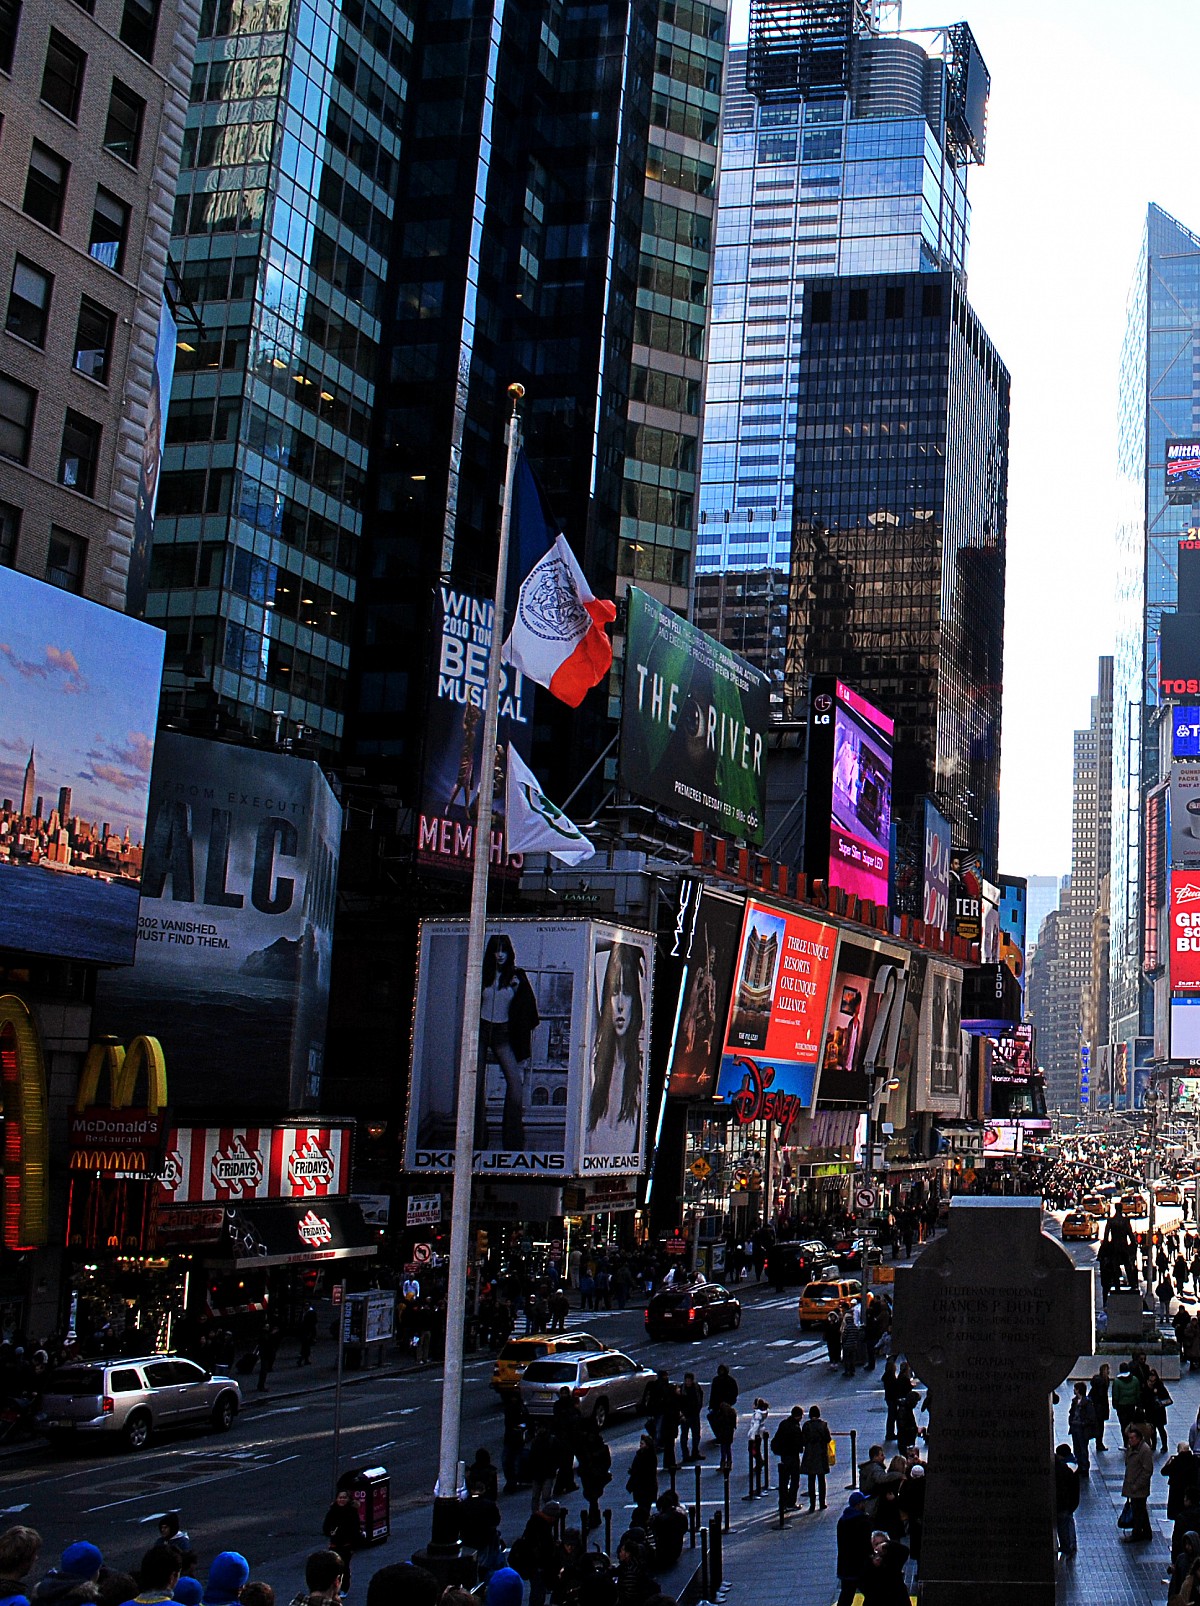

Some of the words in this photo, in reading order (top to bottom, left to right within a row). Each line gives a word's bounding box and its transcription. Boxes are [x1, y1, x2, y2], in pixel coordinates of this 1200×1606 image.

[439, 587, 496, 627] WINN
[443, 615, 469, 639] 2010
[472, 625, 493, 648] TON
[437, 675, 528, 723] MUSIAL
[636, 663, 679, 733] THE
[814, 715, 830, 724] LG
[706, 705, 763, 777] RIVER
[674, 780, 701, 803] PREMIERES
[702, 793, 723, 812] TUESDAY
[723, 802, 732, 816] FEB
[838, 838, 851, 857] Super
[851, 844, 861, 859] Slim
[862, 849, 874, 867] Super
[563, 894, 598, 902] LAMAR
[160, 918, 218, 936] VANISHED.
[168, 932, 195, 946] FIND
[197, 936, 231, 949] THEM.
[787, 935, 807, 953] THREE
[807, 940, 829, 961] UNIQUE
[781, 976, 794, 991] ONE
[794, 980, 817, 997] UNIQUE
[72, 1119, 158, 1133] McDonald's
[85, 1134, 142, 1143] Restaurant
[483, 1153, 565, 1169] JEANS
[583, 1157, 609, 1169] DKNY
[610, 1155, 639, 1168] JEANS
[933, 1299, 988, 1312] FRANCIS
[1007, 1301, 1053, 1313] DUFFY
